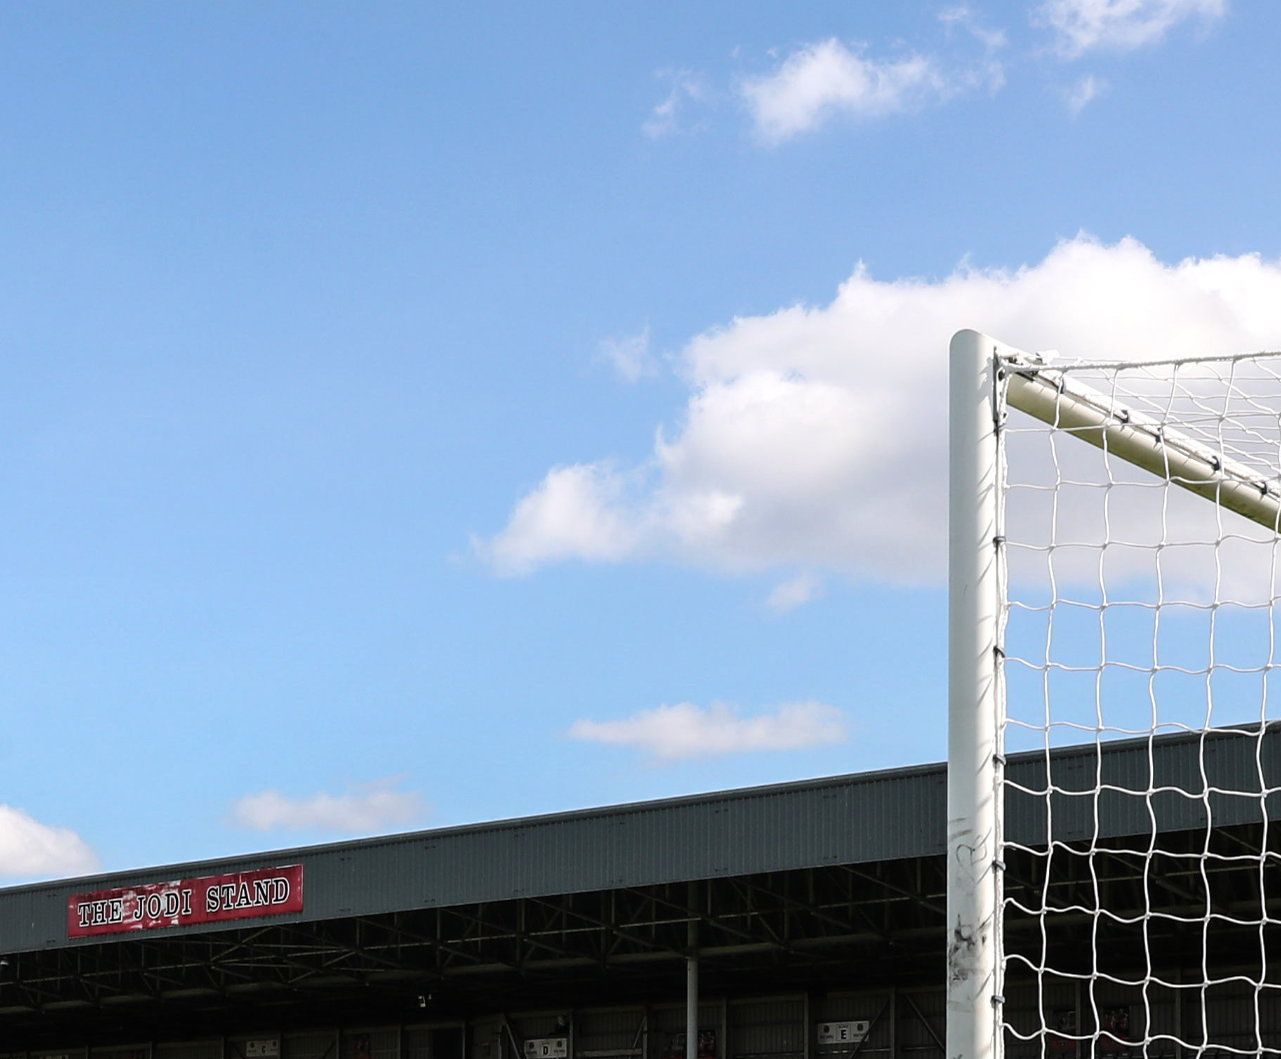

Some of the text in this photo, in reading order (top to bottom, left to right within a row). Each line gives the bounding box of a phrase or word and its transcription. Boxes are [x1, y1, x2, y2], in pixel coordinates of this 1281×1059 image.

[78, 877, 291, 927] THE JODI STAND
[840, 1029, 847, 1040] E
[542, 1045, 549, 1056] D
